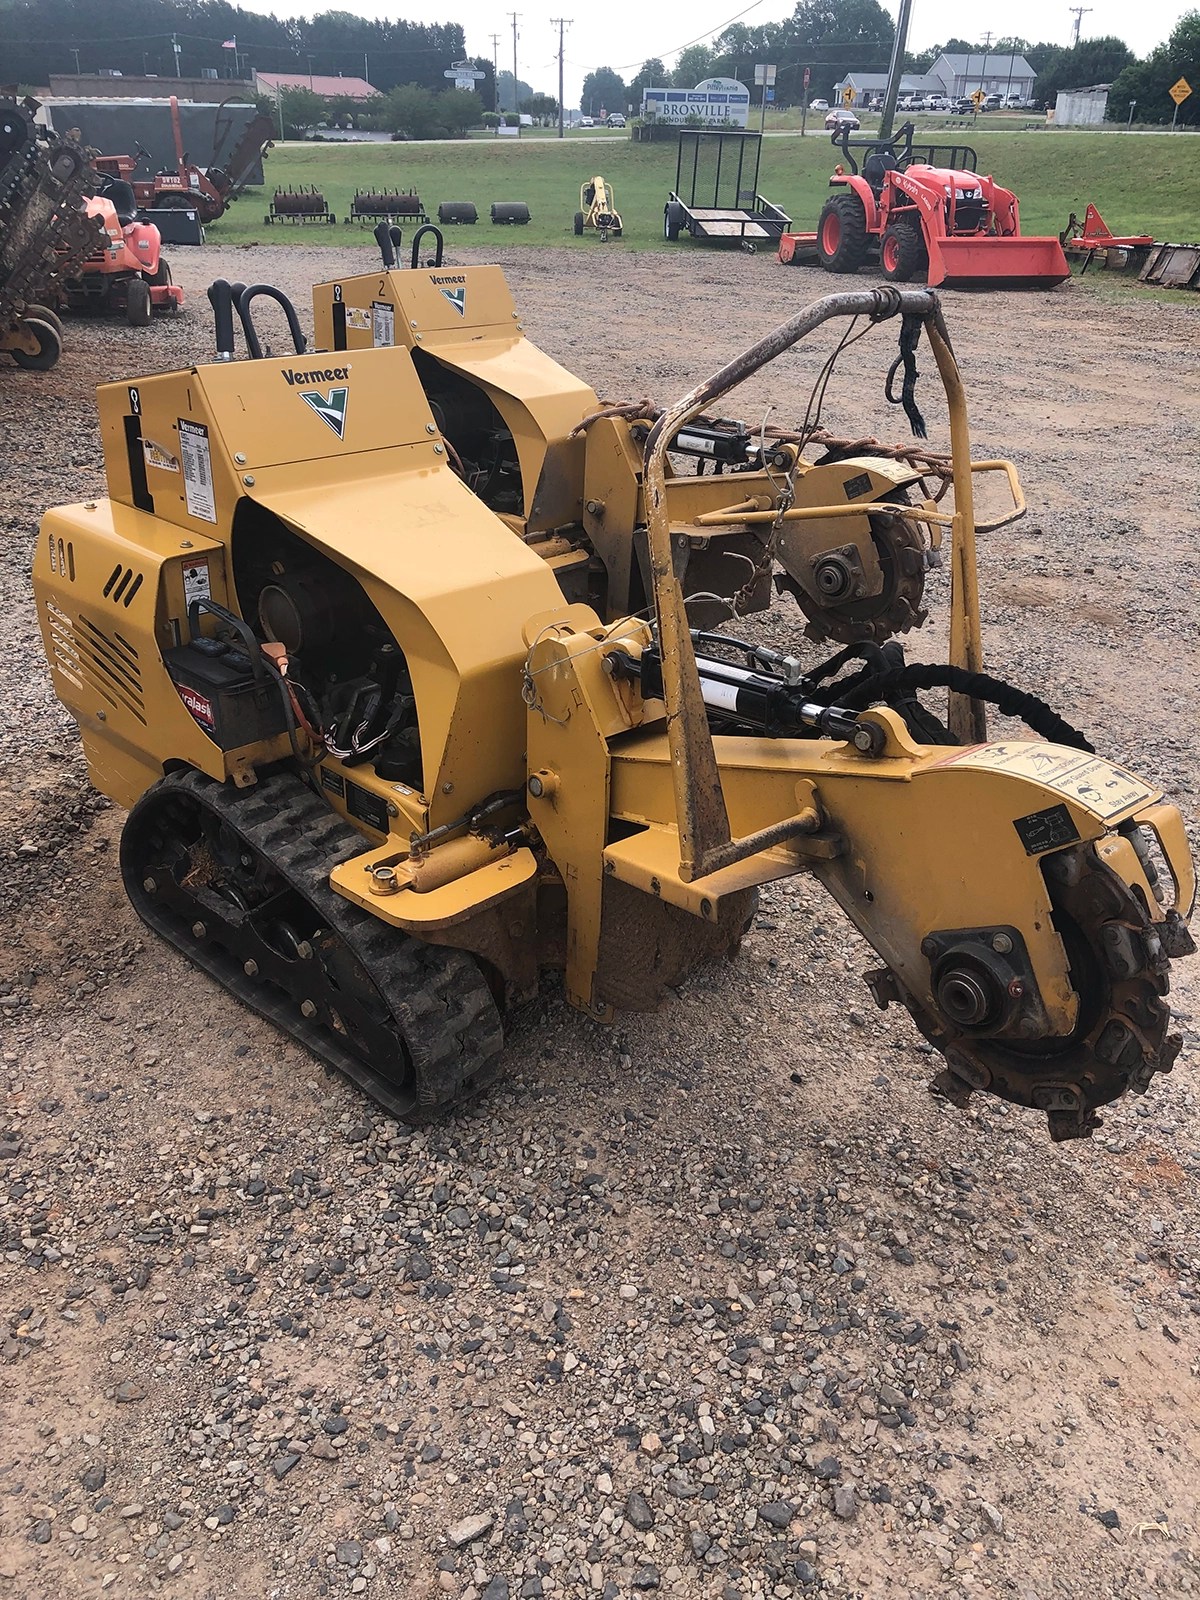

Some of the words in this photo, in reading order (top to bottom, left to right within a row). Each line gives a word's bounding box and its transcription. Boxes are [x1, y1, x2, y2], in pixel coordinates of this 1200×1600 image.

[663, 104, 730, 116] BROSVILLE
[429, 274, 466, 285] Vermeer
[378, 280, 386, 297] 2
[281, 367, 349, 386] Vermeer
[180, 420, 205, 436] Vermeer
[1109, 798, 1125, 808] Stay
[1121, 791, 1140, 801] Away
